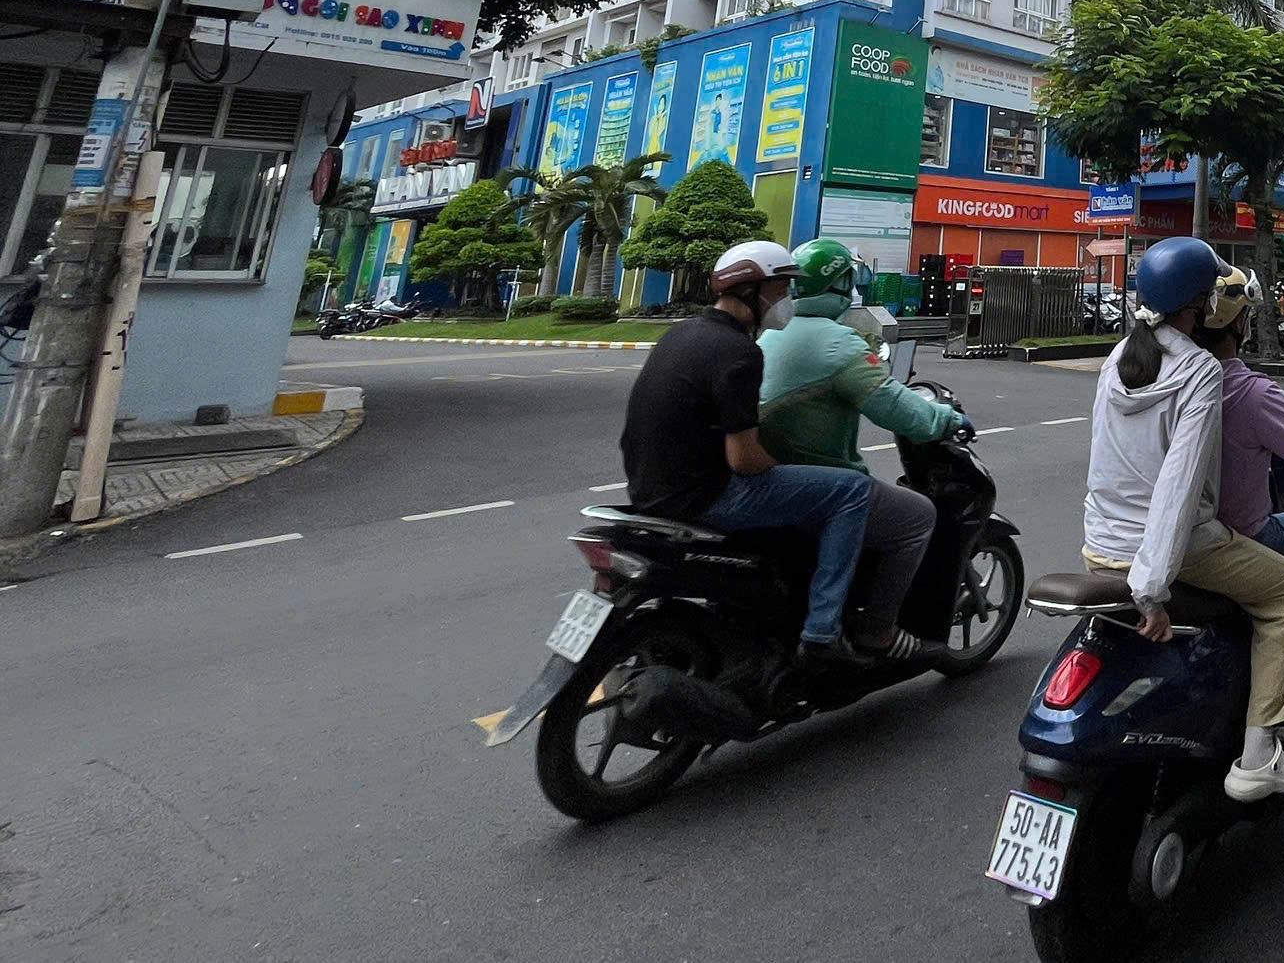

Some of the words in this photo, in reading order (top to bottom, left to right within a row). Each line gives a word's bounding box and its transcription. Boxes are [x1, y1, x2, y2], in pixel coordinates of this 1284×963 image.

[354, 3, 400, 30] SAO
[774, 65, 781, 83] 6
[783, 60, 797, 80] IN
[851, 57, 889, 74] FOOD
[1073, 207, 1090, 224] SIÊ
[1009, 801, 1064, 851] 50-AA
[993, 838, 1059, 892] 775.43
